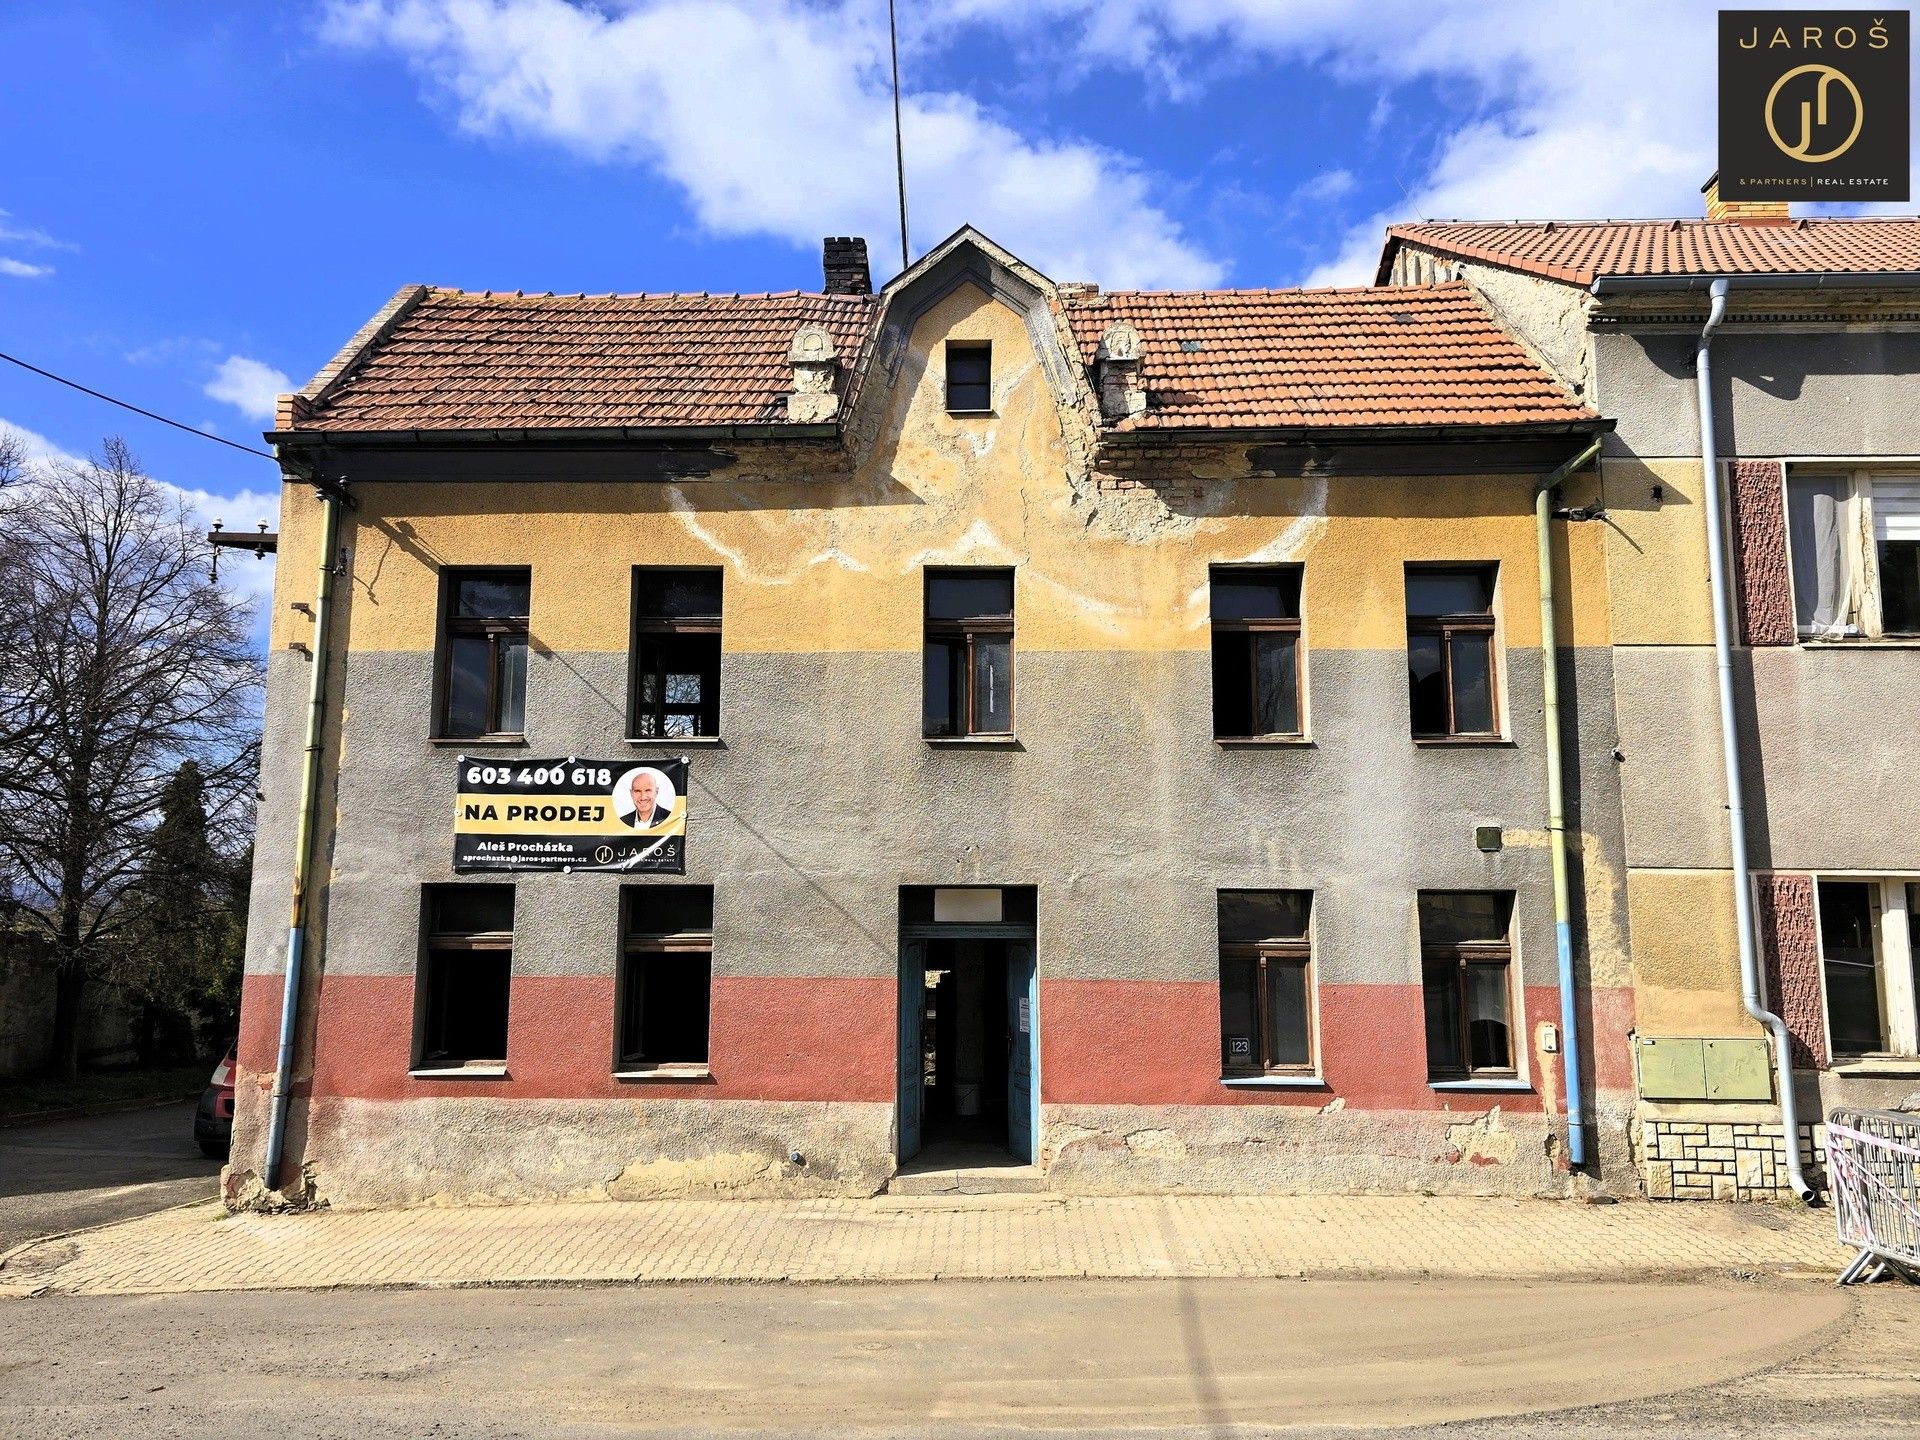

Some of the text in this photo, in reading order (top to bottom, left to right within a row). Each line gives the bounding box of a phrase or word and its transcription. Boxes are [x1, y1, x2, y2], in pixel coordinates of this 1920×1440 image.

[466, 767, 612, 786] 603 400 618
[464, 804, 605, 822] NA PRODEJ
[477, 841, 574, 852] Aleš Procházka
[1231, 1041, 1248, 1052] 123
